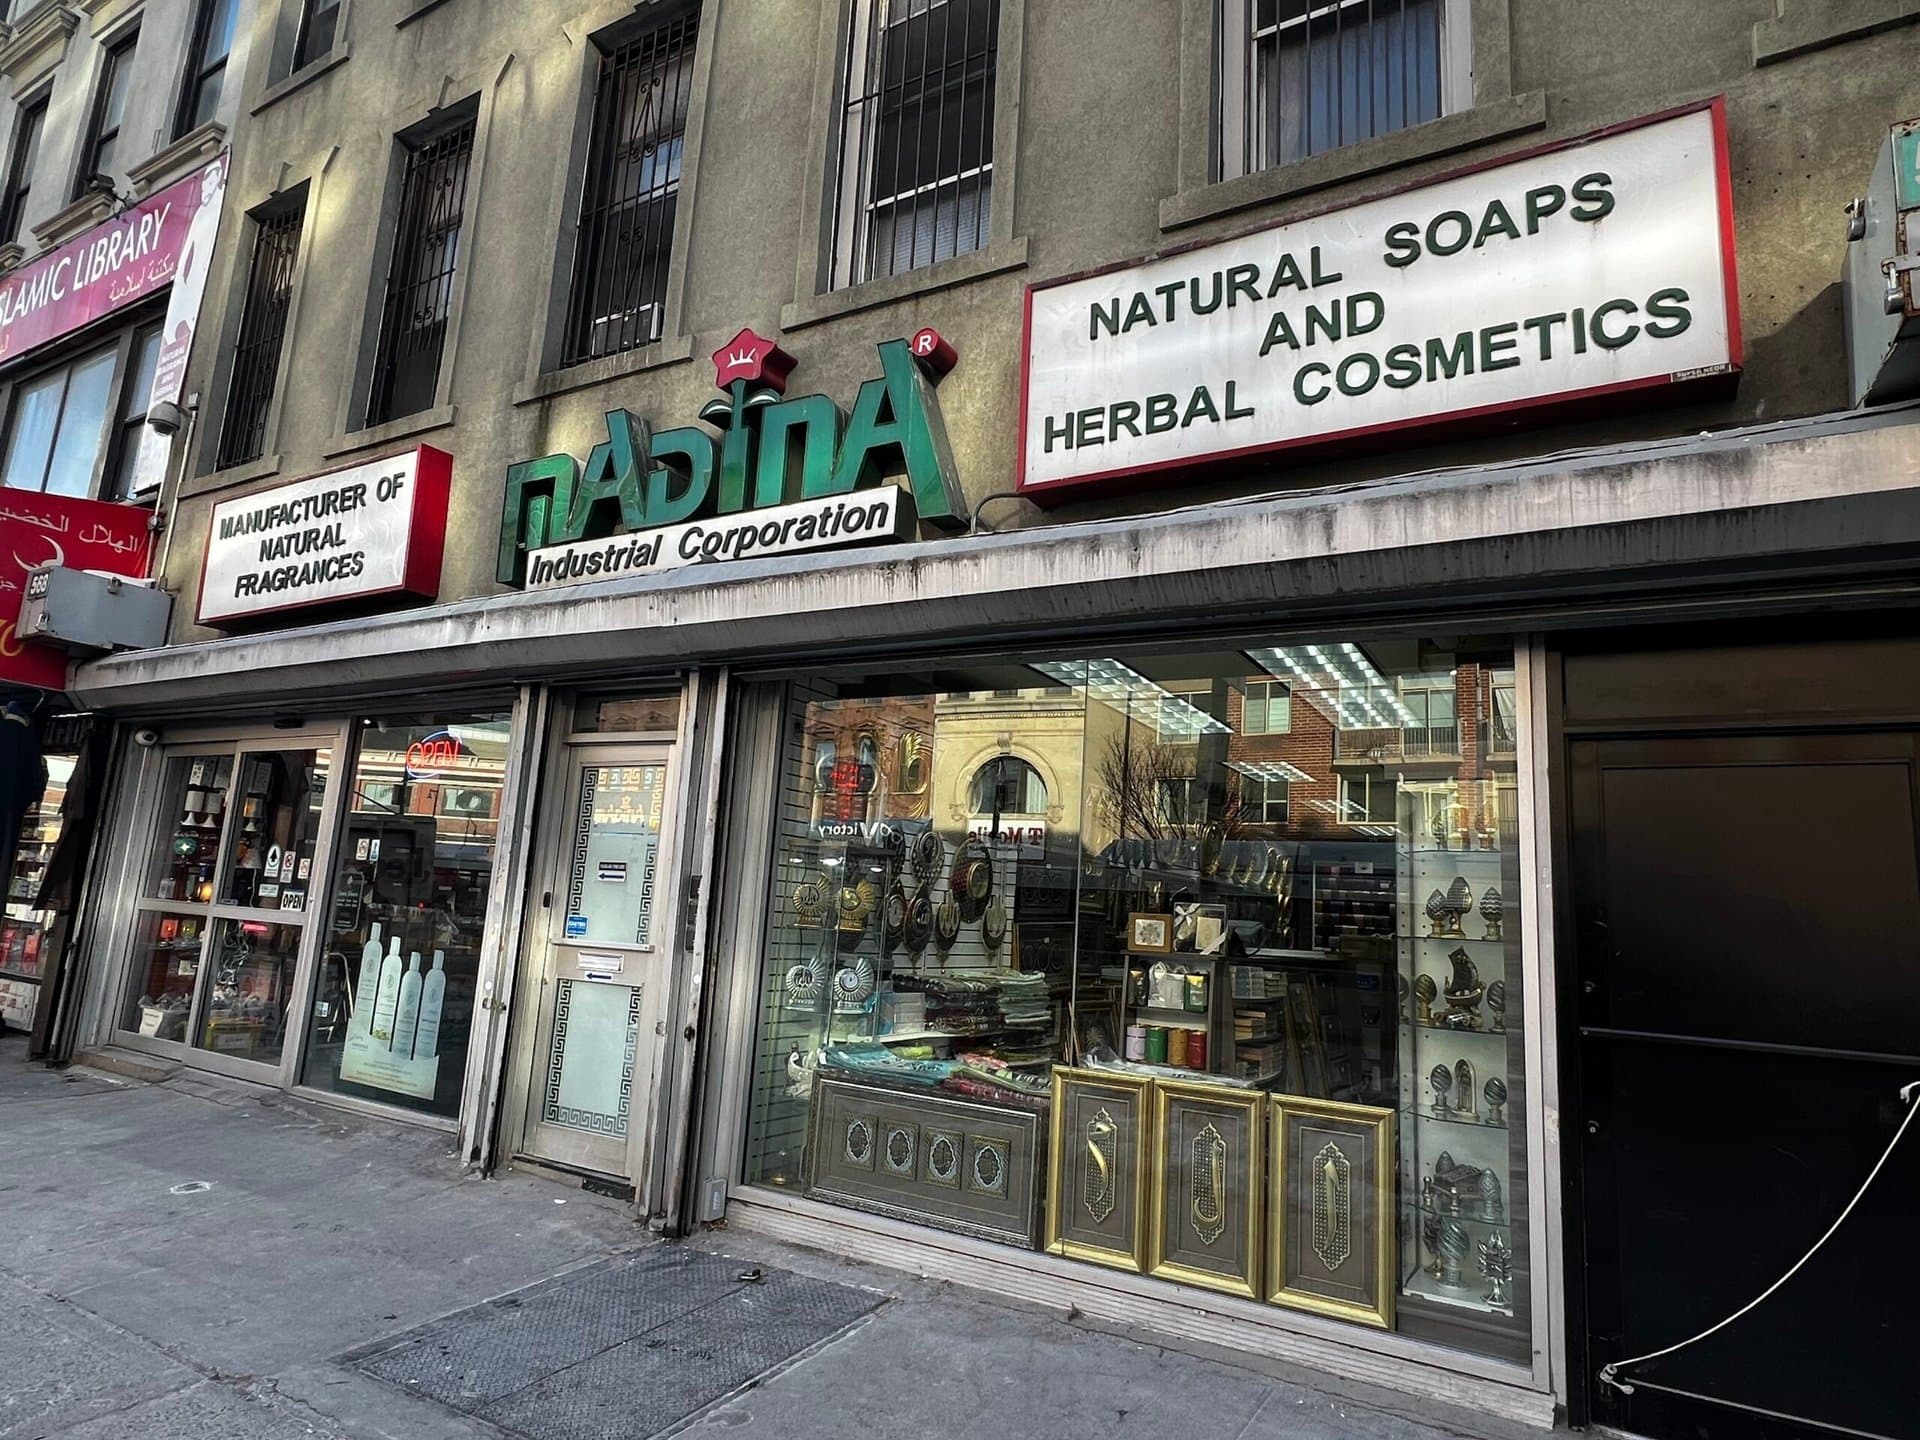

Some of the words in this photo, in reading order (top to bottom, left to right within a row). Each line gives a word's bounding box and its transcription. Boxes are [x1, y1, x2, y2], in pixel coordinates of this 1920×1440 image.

[73, 201, 172, 291] LIBRARY
[1090, 246, 1342, 340] NATURAL
[1383, 171, 1615, 267] SOAPS
[1259, 291, 1386, 357] AND
[1044, 379, 1256, 453] HERBAL
[1292, 287, 1693, 405] COSMETICS
[1703, 365, 1726, 374] NEON
[0, 507, 70, 533] الخضي
[219, 483, 367, 540] MANUFACTURER
[376, 472, 406, 502] OF
[259, 523, 347, 562] NATURAL
[529, 534, 663, 584] Industrial
[678, 500, 888, 560] Corporation
[234, 551, 365, 598] FRAGRANCES
[407, 740, 460, 768] OPEN
[283, 893, 304, 909] OPEN
